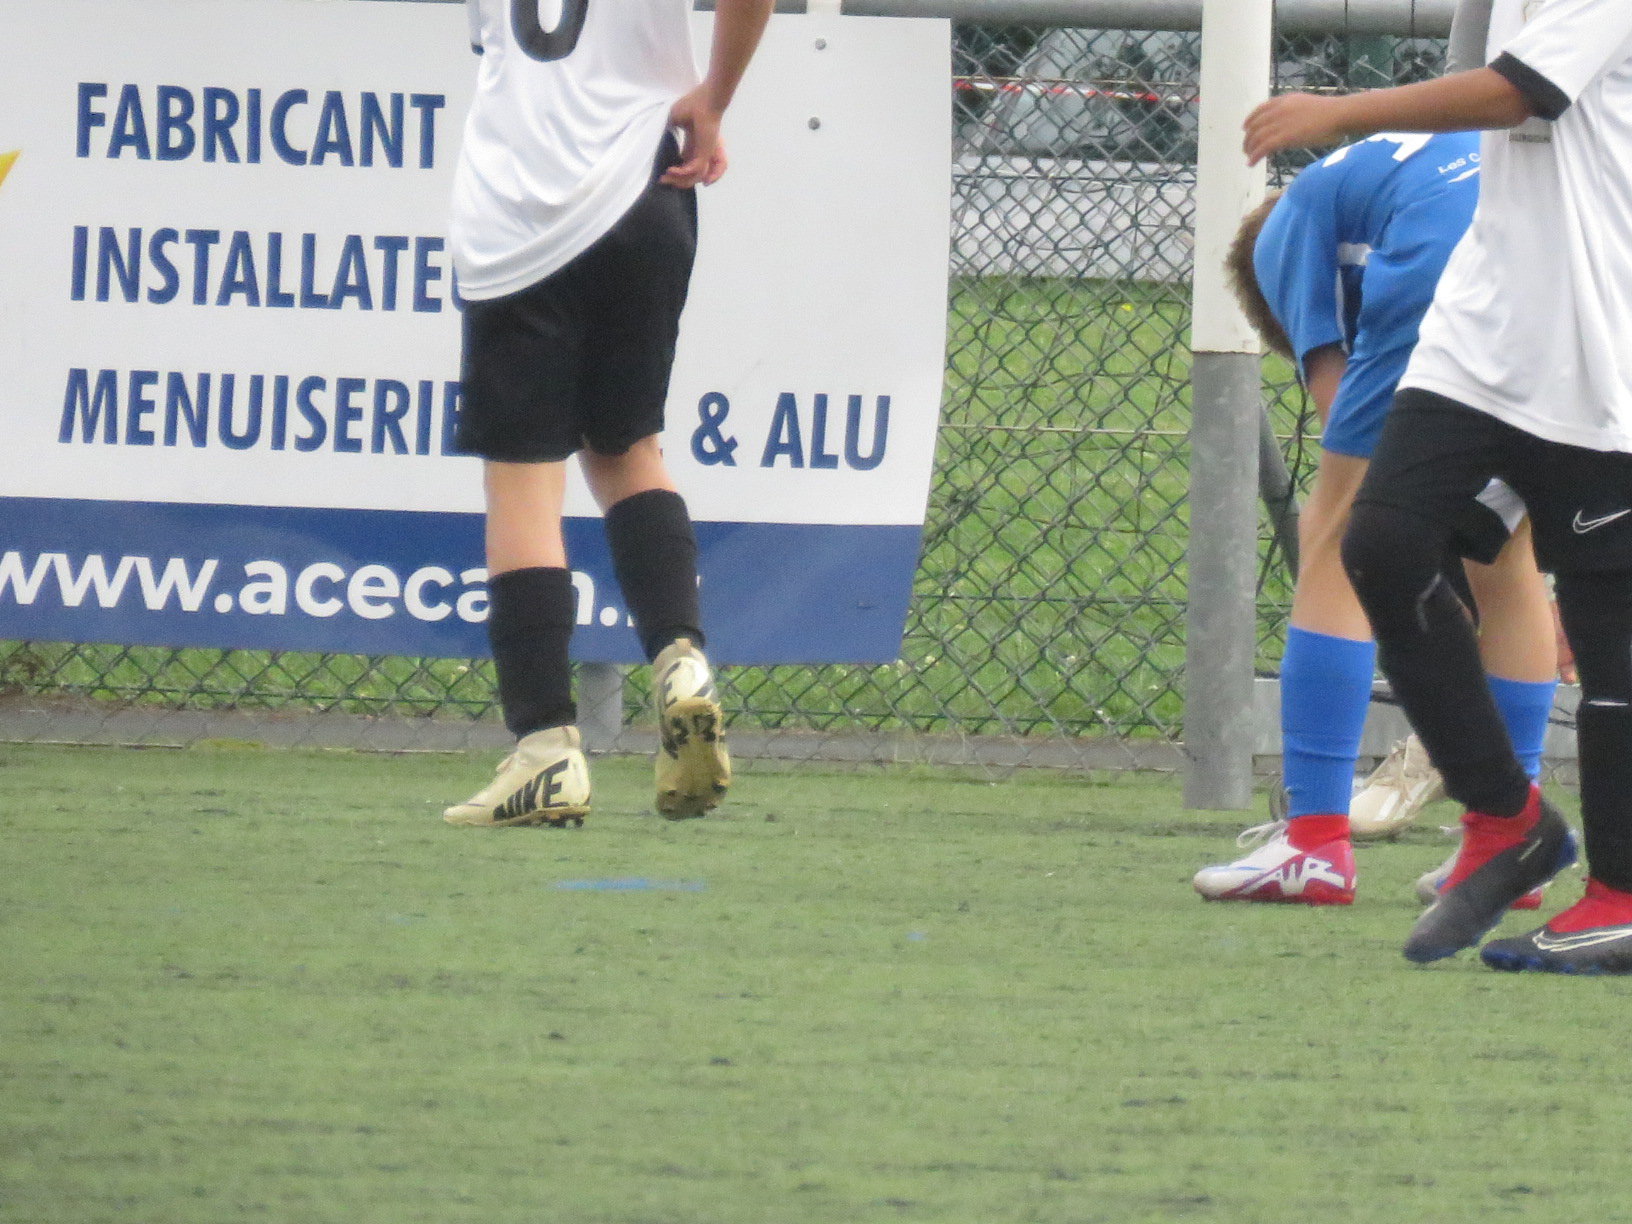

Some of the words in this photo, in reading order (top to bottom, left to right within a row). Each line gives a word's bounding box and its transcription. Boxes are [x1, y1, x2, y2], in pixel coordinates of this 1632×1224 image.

[75, 82, 446, 169] FABRICANT
[70, 225, 466, 313] INSTALLATE
[58, 367, 475, 458] MENUISERIE
[690, 391, 738, 466] &
[760, 392, 891, 471] ALU
